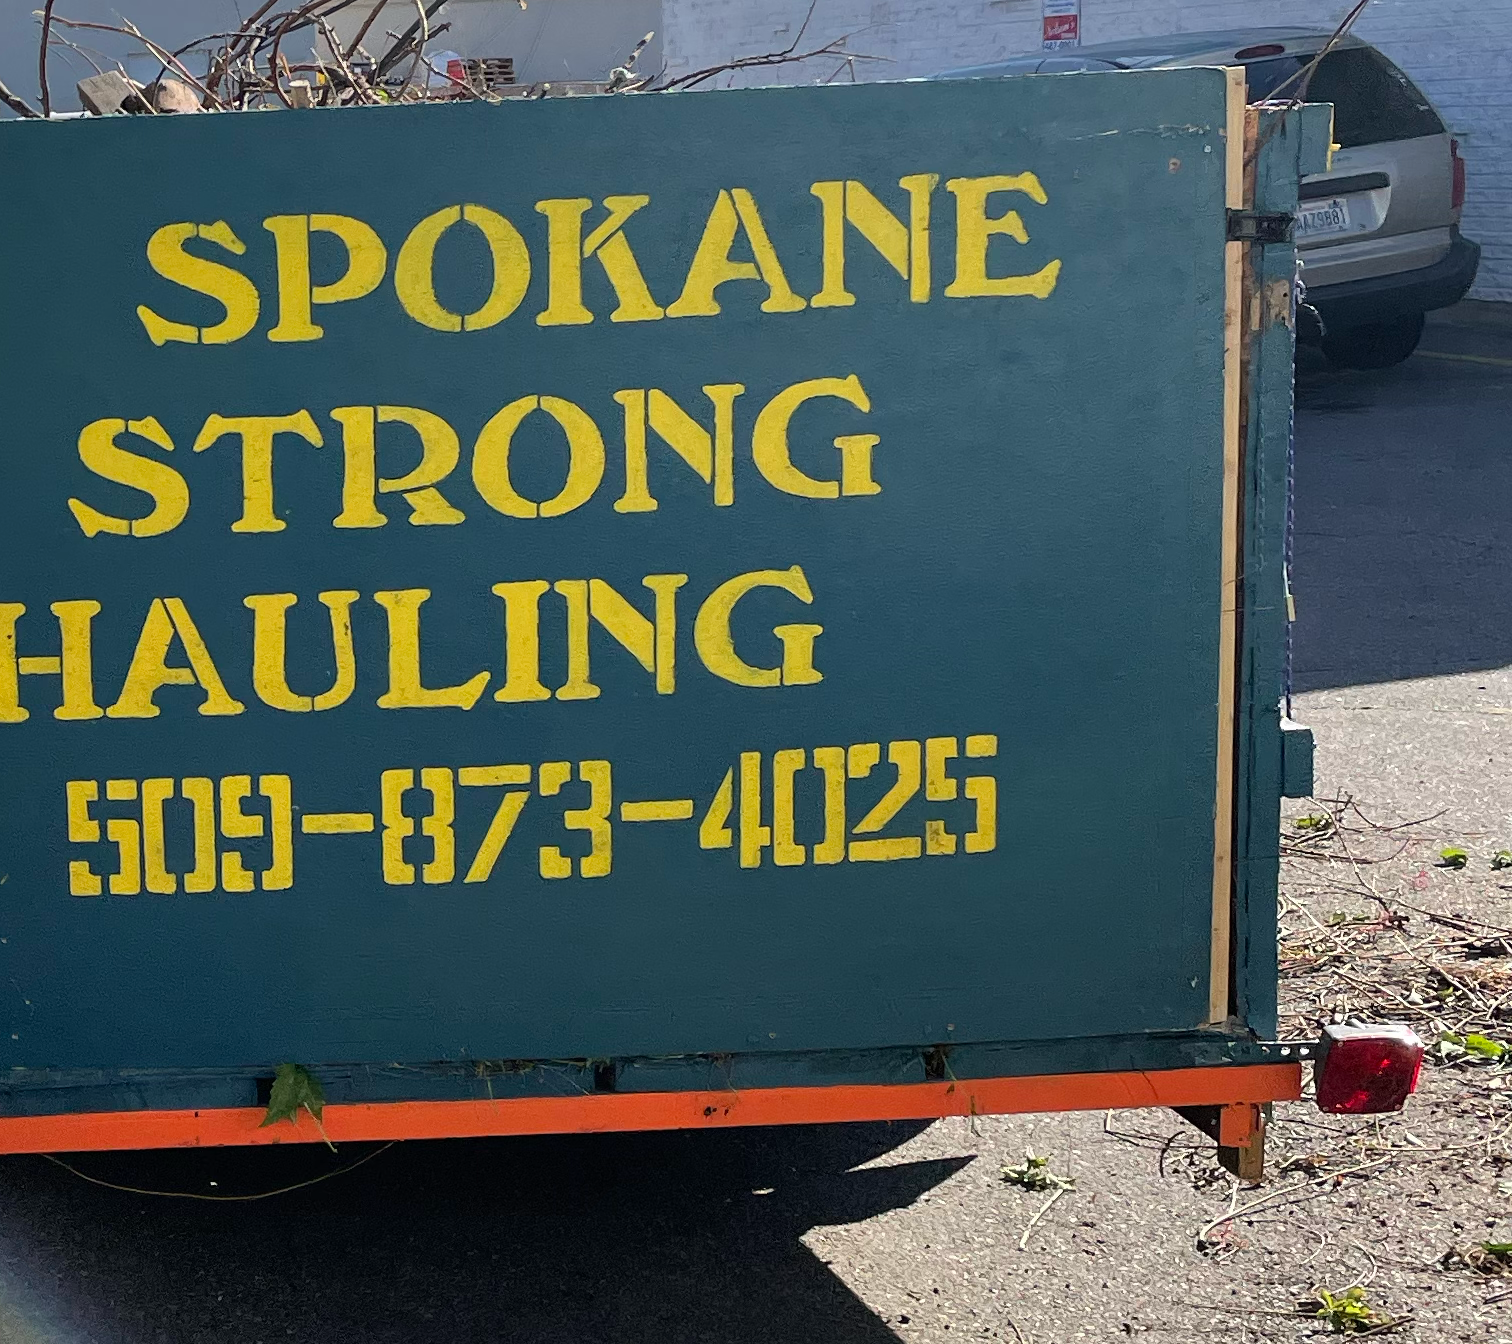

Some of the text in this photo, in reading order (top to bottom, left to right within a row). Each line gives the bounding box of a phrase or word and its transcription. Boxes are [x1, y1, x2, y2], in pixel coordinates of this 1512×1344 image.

[137, 172, 1062, 346] SPOKANE
[67, 373, 882, 537] STRONG
[66, 733, 998, 896] 509-873-4025
